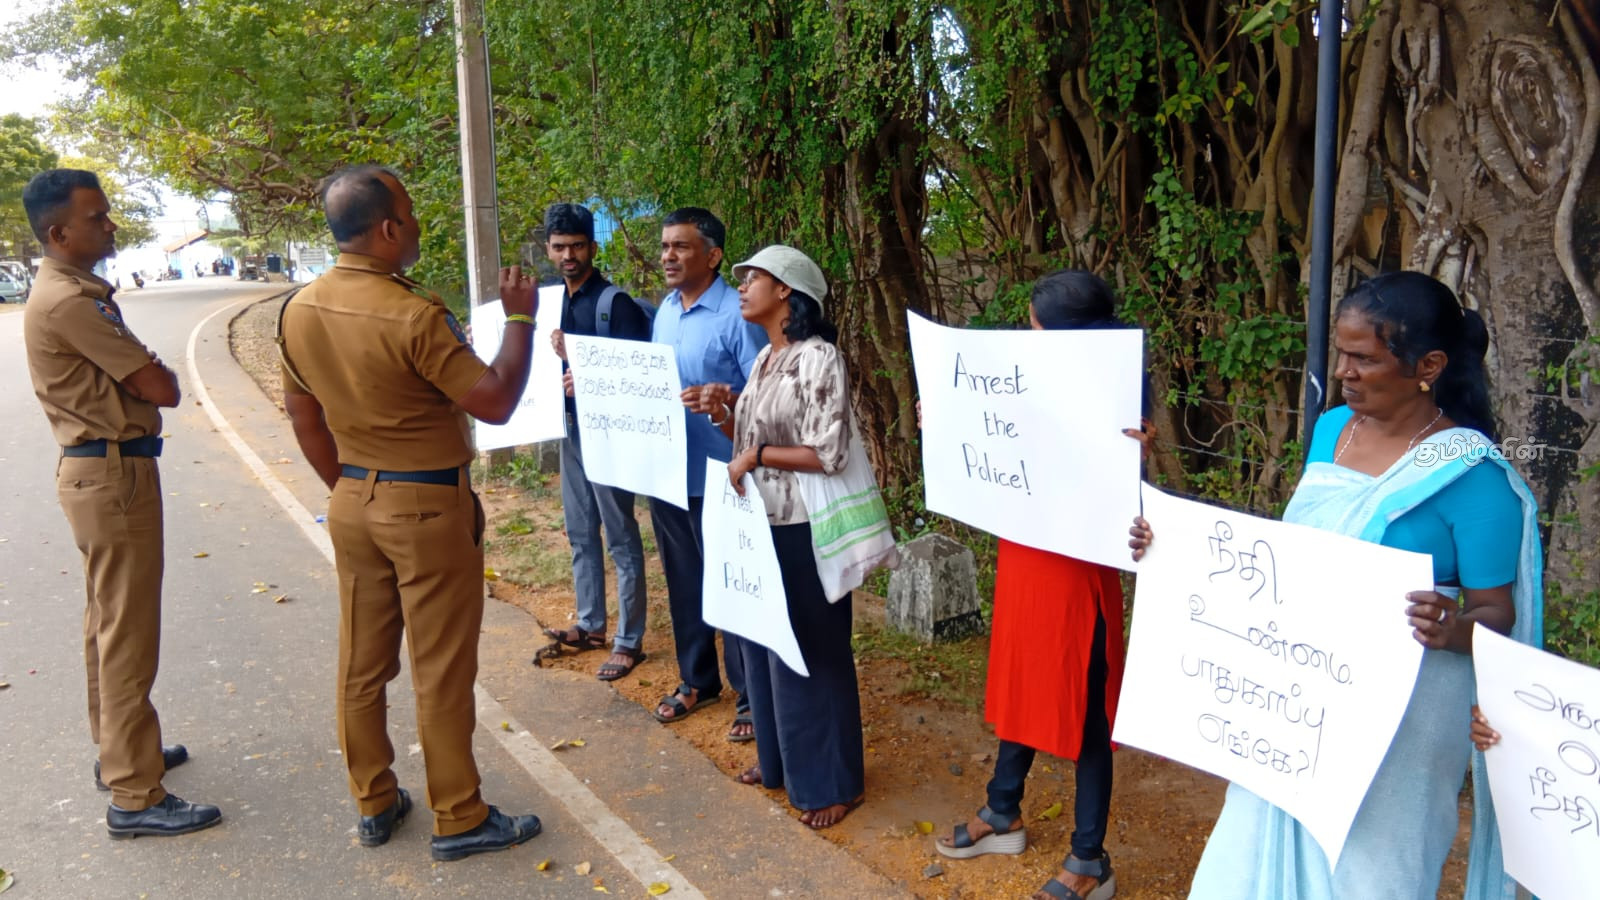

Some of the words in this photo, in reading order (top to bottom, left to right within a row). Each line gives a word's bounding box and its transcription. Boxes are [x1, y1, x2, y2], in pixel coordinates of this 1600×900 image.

[954, 352, 1028, 395] Arrest
[983, 411, 1019, 439] the
[962, 442, 1032, 496] Police!
[737, 527, 755, 551] the
[723, 561, 764, 601] Police!
[1180, 654, 1326, 778] பாதுகாப்பு
[1197, 713, 1310, 777] எங்கே?
